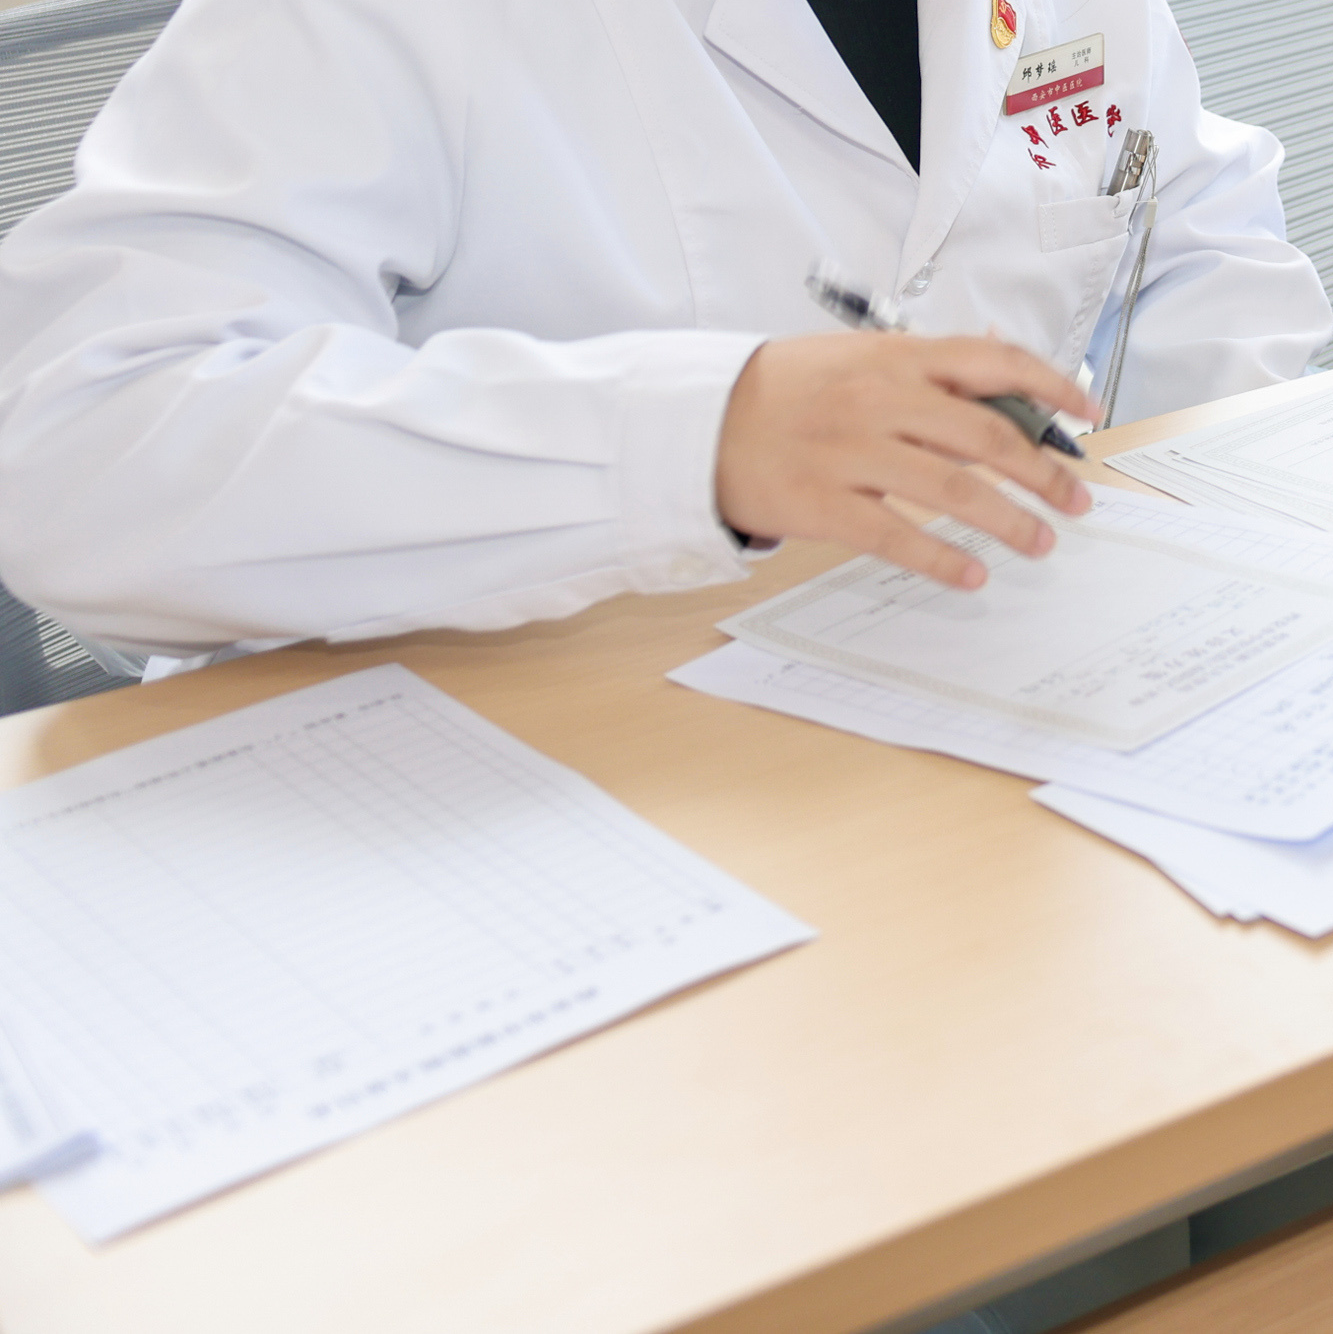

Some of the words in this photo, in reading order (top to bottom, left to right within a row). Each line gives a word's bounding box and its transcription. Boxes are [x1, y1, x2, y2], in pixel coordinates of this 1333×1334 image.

[1031, 78, 1083, 102] 西安市中医医院
